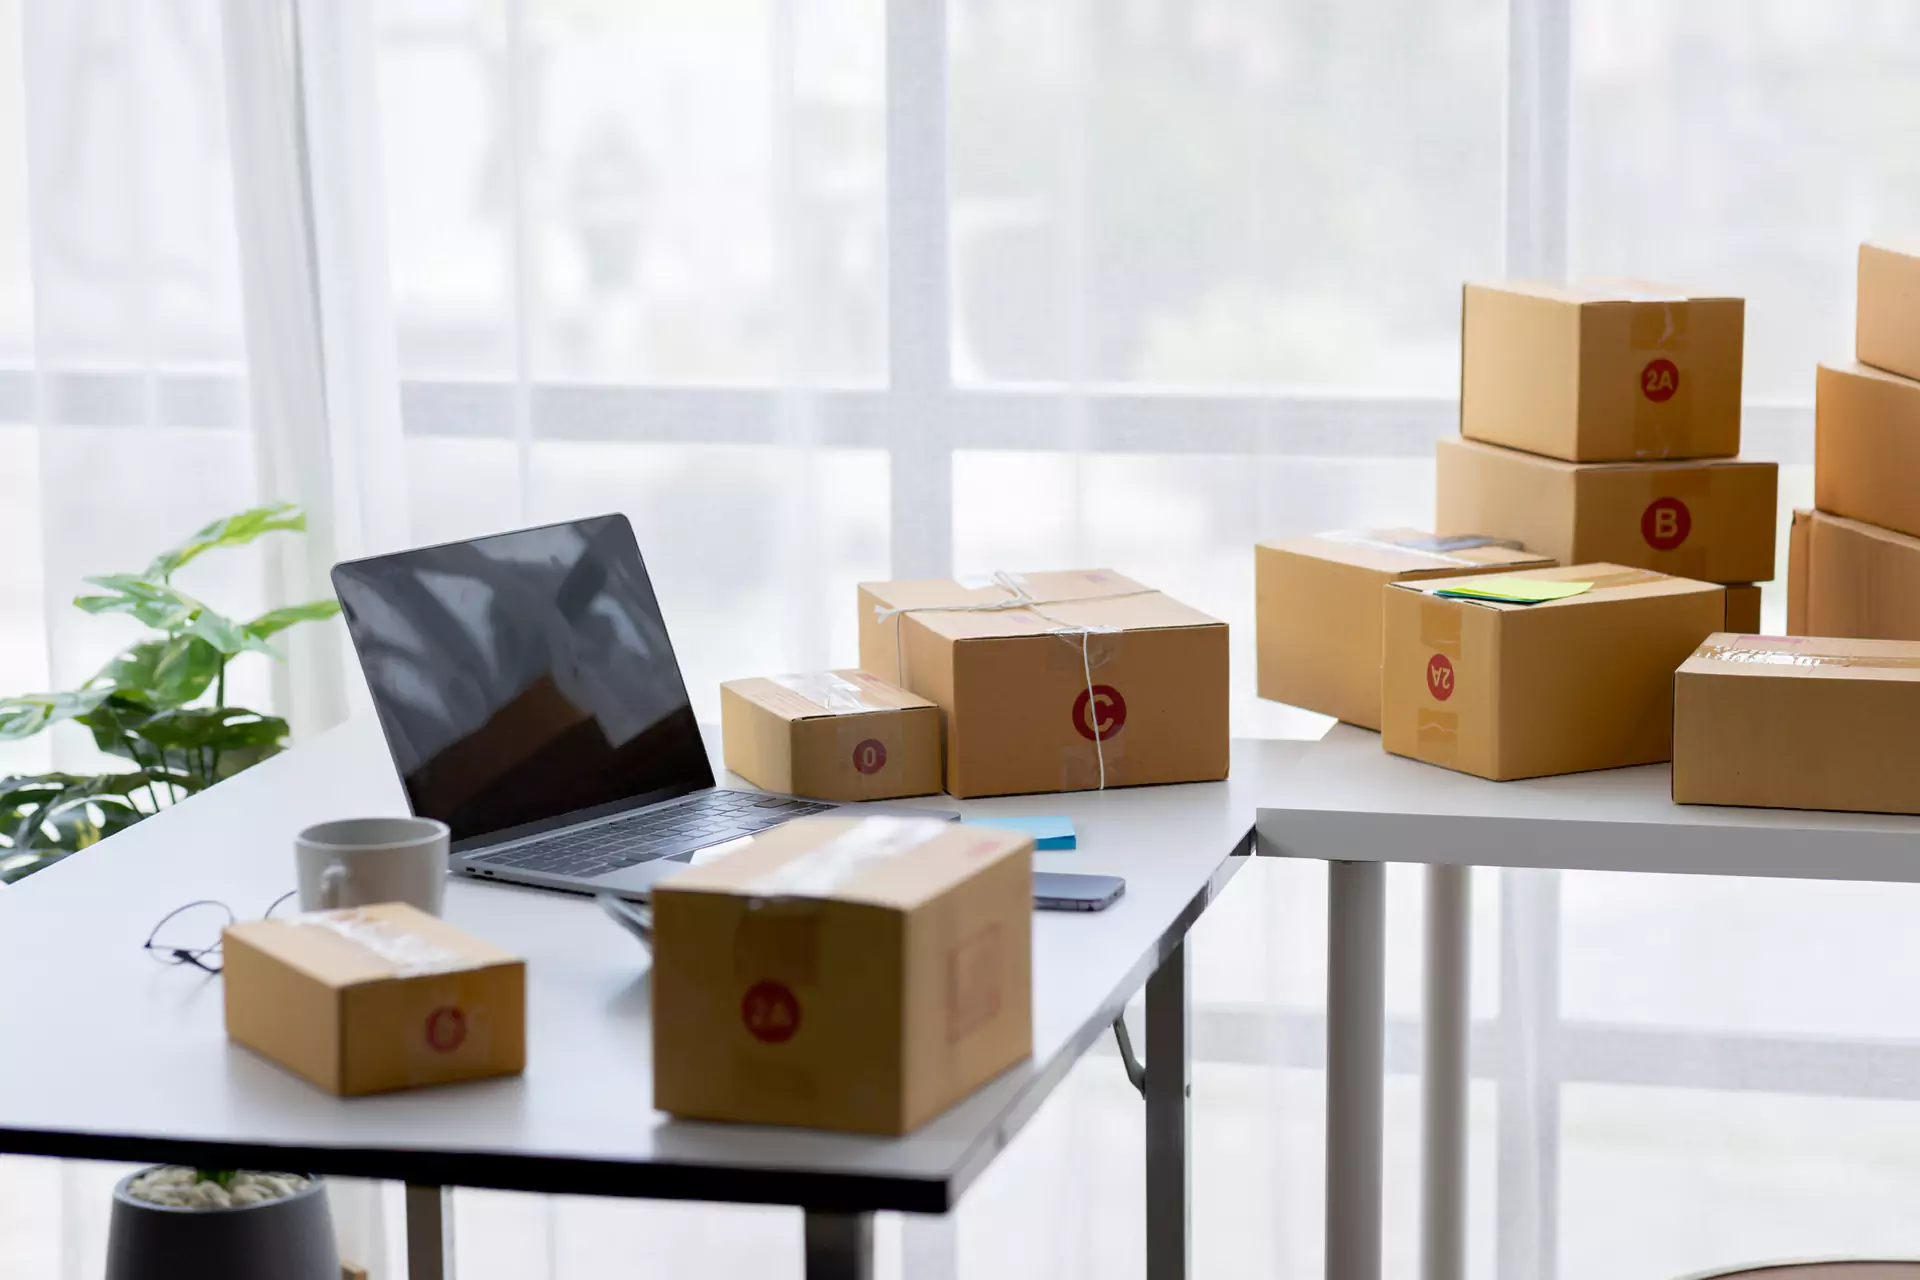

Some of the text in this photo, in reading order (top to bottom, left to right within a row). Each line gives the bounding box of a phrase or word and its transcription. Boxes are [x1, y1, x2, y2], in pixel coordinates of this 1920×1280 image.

[1646, 369, 1673, 391] 2A
[1655, 508, 1678, 539] B
[1431, 663, 1450, 689] 2A
[1083, 694, 1114, 732] C
